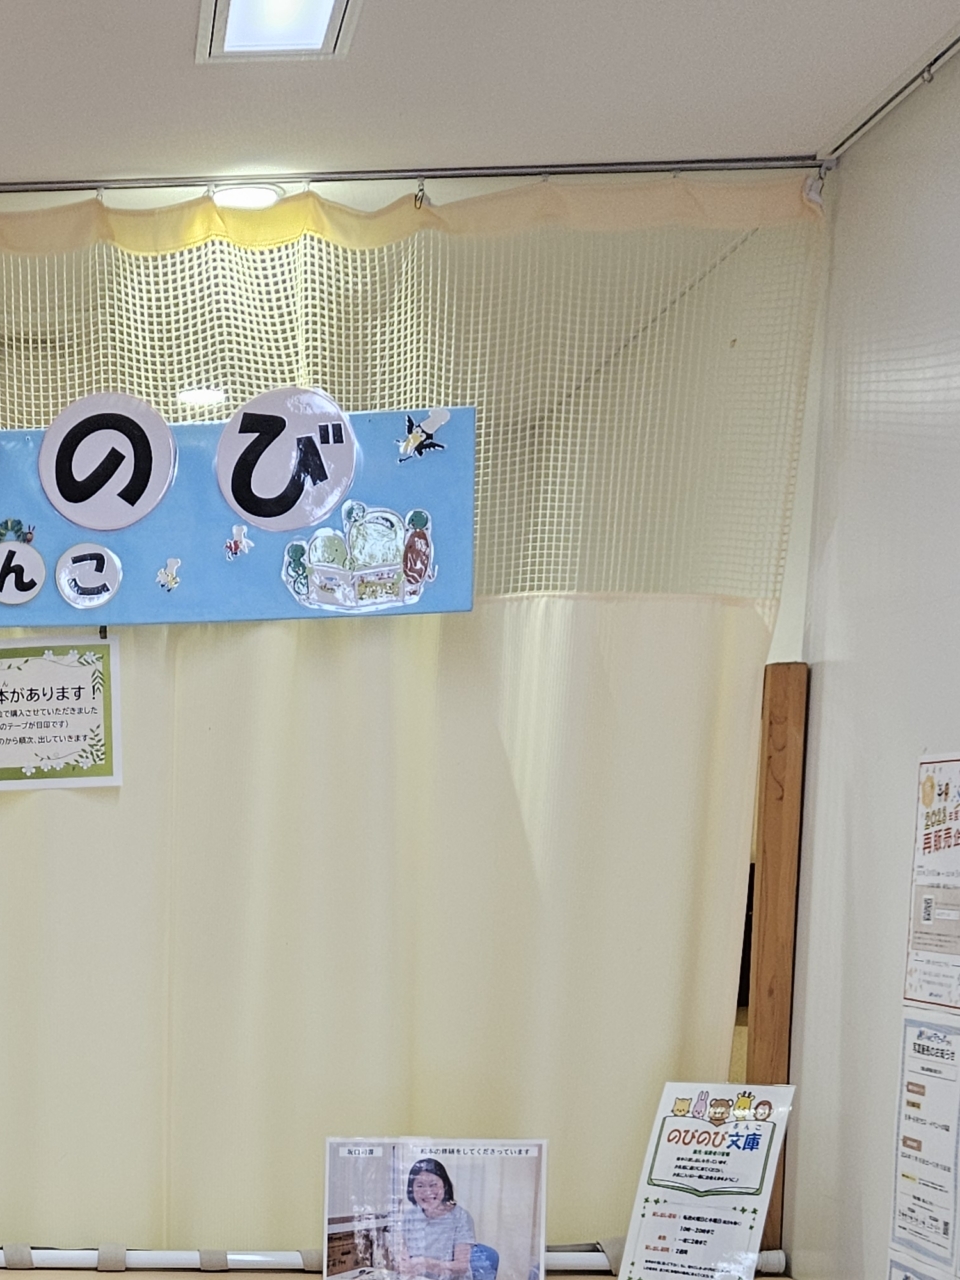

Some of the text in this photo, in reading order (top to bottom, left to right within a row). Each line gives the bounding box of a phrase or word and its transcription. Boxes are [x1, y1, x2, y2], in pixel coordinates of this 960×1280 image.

[666, 1128, 762, 1152] のびのび文庫
